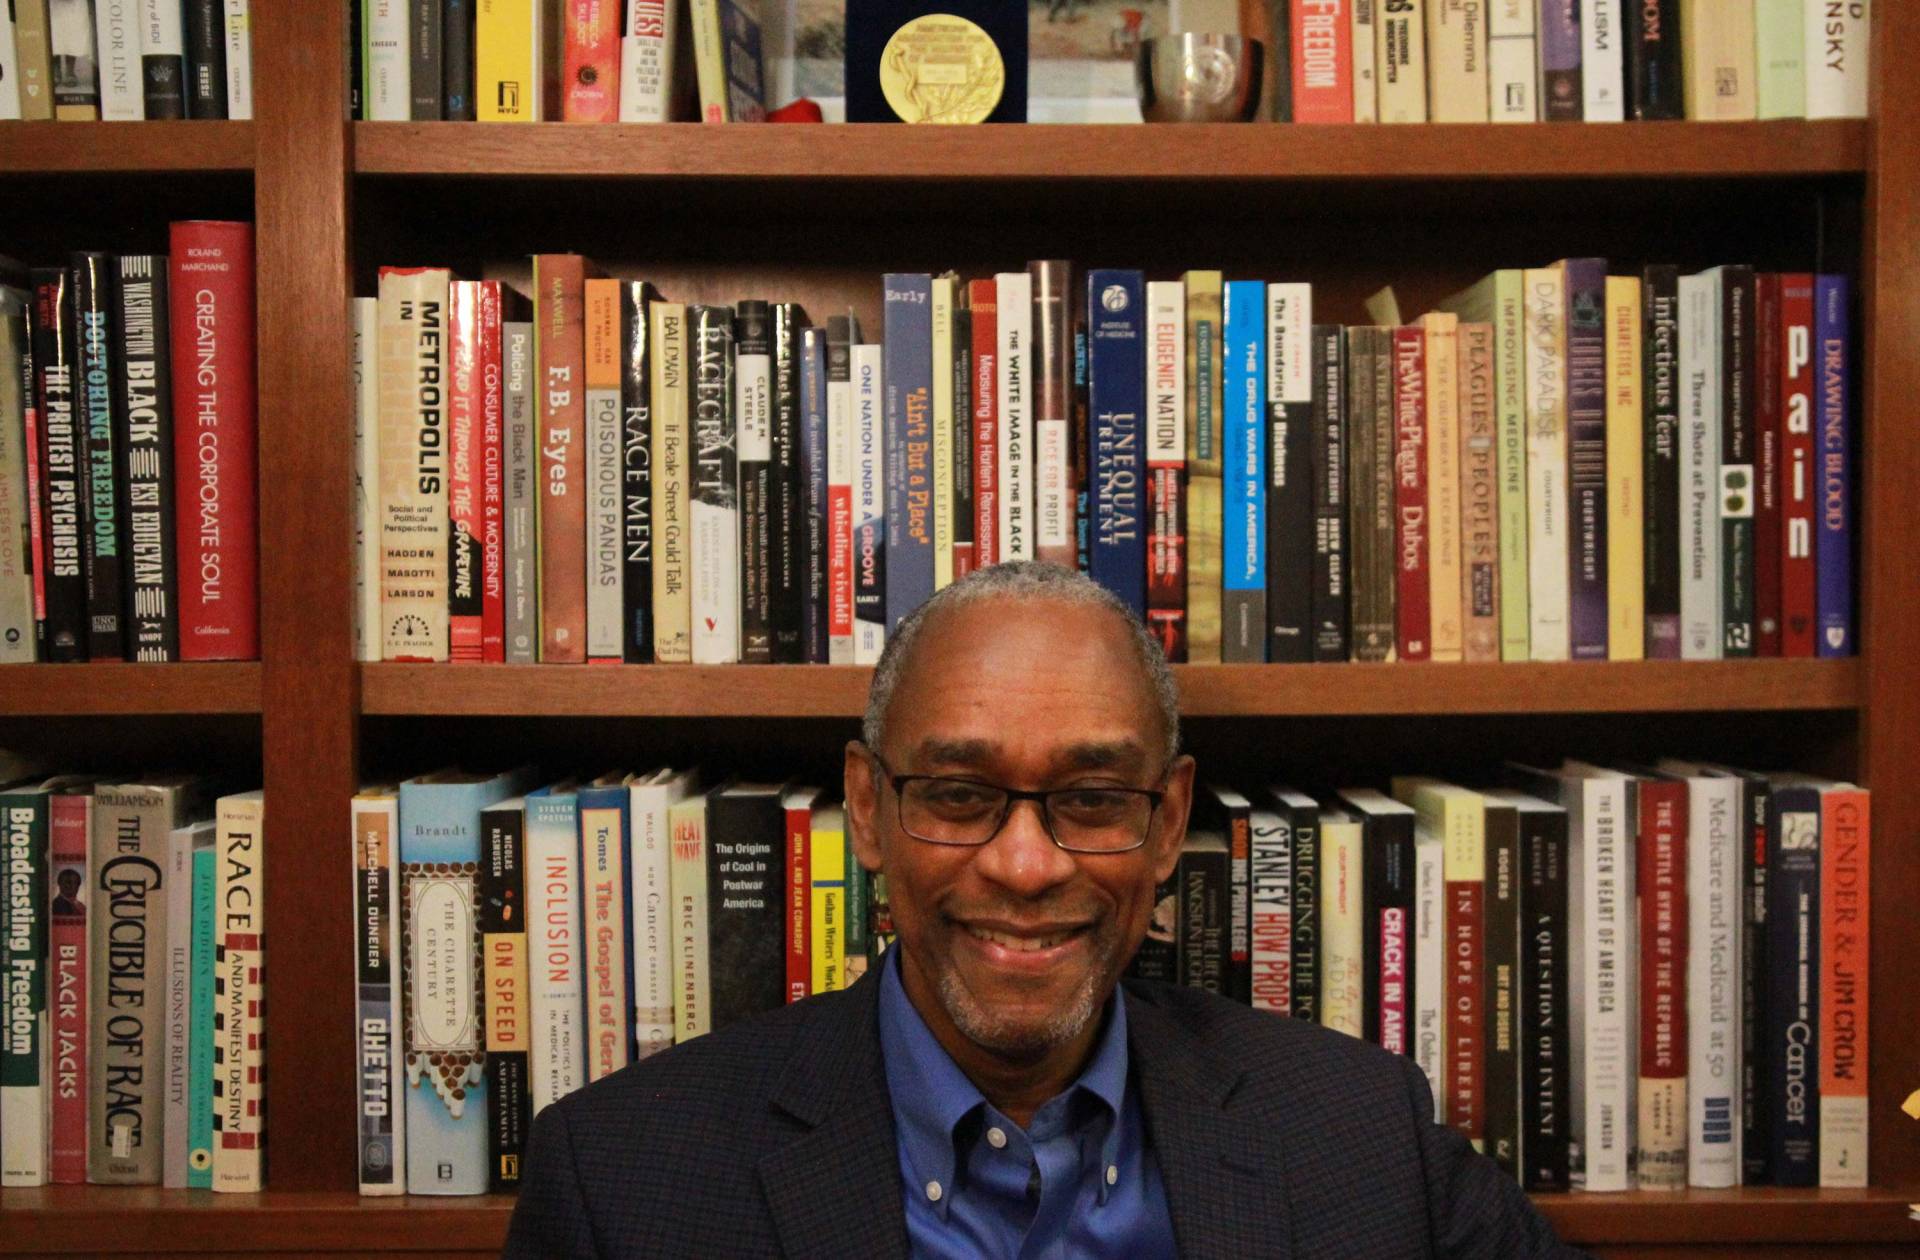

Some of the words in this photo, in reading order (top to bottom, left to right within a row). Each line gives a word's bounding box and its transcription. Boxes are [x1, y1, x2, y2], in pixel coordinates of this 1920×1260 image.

[231, 13, 243, 50] Line
[1302, 0, 1341, 88] FREEDOM
[1464, 2, 1478, 73] Dilemma
[112, 57, 128, 94] LINE
[123, 282, 154, 355] WASHINGTON
[400, 301, 412, 320] IN
[552, 278, 562, 338] MAXWELL
[885, 289, 926, 304] Early
[1275, 298, 1285, 320] The
[196, 290, 216, 386] CREATING
[510, 334, 525, 391] Policing
[1009, 330, 1017, 350] THE
[1157, 323, 1174, 388] EUGENIC
[1247, 342, 1256, 372] THE
[1275, 326, 1285, 399] Boundaries
[1504, 299, 1516, 406] IMPROVISING
[1655, 296, 1676, 406] infectious
[45, 365, 70, 393] THE
[83, 311, 111, 439] DOCTORING
[126, 361, 158, 442] BLACK
[419, 301, 440, 494] METROPOLIS
[456, 397, 470, 408] IT
[550, 366, 570, 415] F.B.
[780, 360, 791, 400] black
[861, 365, 872, 395] ONE
[977, 355, 993, 417] Measuring
[1008, 355, 1020, 403] WHITE
[1247, 378, 1256, 423] DRUG
[1469, 331, 1487, 434] PLAGUES
[1692, 371, 1705, 417] Three
[1824, 339, 1841, 448] DRAWING
[198, 392, 216, 425] THE
[484, 364, 498, 443] CONSUMER
[512, 396, 526, 422] the
[696, 326, 721, 493] RACECRAFT
[744, 386, 753, 431] STEELE
[861, 400, 873, 454] NATION
[980, 422, 993, 440] the
[1157, 394, 1174, 449] NATION
[1275, 404, 1285, 417] of
[45, 401, 75, 473] PROTEST
[454, 416, 470, 481] THROUGH
[512, 424, 526, 463] Black
[544, 428, 570, 496] Eyes
[600, 399, 616, 508] POISONOUS
[626, 406, 649, 482] RACE
[781, 406, 791, 467] interior
[1009, 409, 1020, 461] IMAGE
[1046, 430, 1058, 460] RACE
[1247, 428, 1256, 475] WARS
[1275, 422, 1286, 486] Blackness
[1507, 414, 1519, 493] MEDICINE
[1656, 414, 1676, 457] fear
[1693, 421, 1705, 465] Shots
[198, 432, 218, 546] CORPORATE
[485, 447, 498, 504] CULTURE
[513, 468, 527, 499] Man
[861, 460, 872, 505] UNDER
[936, 420, 947, 553] MISCONCEPTION
[980, 445, 993, 487] Harlem
[1010, 465, 1019, 477] IN
[1010, 482, 1019, 502] THE
[1046, 465, 1058, 489] FOR
[1098, 412, 1112, 545] TREATMENT
[1109, 412, 1135, 545] UNEQUAL
[1247, 481, 1256, 496] IN
[1693, 471, 1705, 486] at
[1826, 454, 1842, 530] BLOOD
[50, 480, 79, 576] PSYCHOSIS
[91, 450, 116, 557] FREEDOM
[388, 505, 413, 513] Social
[417, 505, 433, 513] and
[455, 486, 471, 515] THE
[486, 507, 498, 515] &
[862, 511, 873, 520] A
[1046, 494, 1059, 537] PROFIT
[384, 524, 438, 533] Perspectives
[600, 514, 616, 586] PANDAS
[627, 495, 650, 562] MEN
[832, 498, 848, 567] whistling
[862, 525, 874, 586] GROOVE
[980, 492, 994, 567] Renaissance
[1010, 507, 1021, 554] BLACK
[1245, 502, 1256, 580] AMERICA,
[1693, 492, 1705, 580] Prevention
[201, 553, 220, 603] SOUL
[455, 519, 472, 599] GRAPEVINE
[486, 521, 499, 598] MODERNITY
[388, 590, 435, 598] LARSON
[835, 572, 849, 624] vivaldi
[118, 816, 140, 853] THE
[415, 823, 467, 836] Brandt
[492, 828, 502, 877] RASMUSSEN
[503, 835, 513, 870] NICOLAS
[597, 827, 609, 871] Tomes
[716, 844, 733, 854] The
[736, 844, 770, 855] Origins
[1709, 797, 1726, 891] Medicare
[10, 807, 35, 951] Broadcasting
[227, 832, 251, 930] RACE
[368, 831, 379, 902] MITCHELL
[720, 862, 730, 872] of
[732, 862, 754, 872] Cool
[757, 862, 766, 872] in
[723, 880, 763, 890] Postwar
[1254, 827, 1289, 906] STANLEY
[1296, 827, 1314, 941] DRUGGING
[444, 901, 455, 933] THE
[546, 856, 569, 982] INCLUSION
[683, 896, 693, 930] ERIC
[723, 898, 764, 909] America
[1458, 890, 1471, 912] IN
[1709, 895, 1726, 929] and
[101, 856, 162, 1007] CRUCIBLE
[368, 907, 379, 968] DUNEIER
[494, 942, 514, 967] ON
[1255, 913, 1289, 953] HOW
[1384, 908, 1401, 975] CRACK
[1458, 926, 1471, 983] HOPE
[59, 945, 77, 1018] BLACK
[172, 947, 185, 1020] ILLUSIONS
[232, 953, 243, 988] AND
[427, 928, 437, 1000] CENTURY
[446, 938, 456, 1027] CIGARETTE
[684, 936, 696, 1031] KLINENBERG
[1297, 948, 1313, 987] THE
[1709, 934, 1727, 1023] Medicaid
[11, 960, 36, 1055] Freedom
[496, 979, 516, 1042] SPEED
[1384, 983, 1401, 1002] IN
[1458, 997, 1471, 1024] OF
[108, 1015, 143, 1056] OF
[172, 1023, 184, 1040] OF
[230, 990, 243, 1066] MANIFEST
[1384, 1008, 1402, 1054] AME
[1710, 1031, 1724, 1049] at
[59, 1029, 77, 1099] JACKS
[171, 1046, 184, 1106] REALITY
[363, 1018, 387, 1117] GHETTO
[1459, 1038, 1472, 1129] LIBERTY
[1707, 1054, 1723, 1077] 50
[1787, 1022, 1810, 1124] Cancer
[229, 1070, 242, 1131] DESTINY
